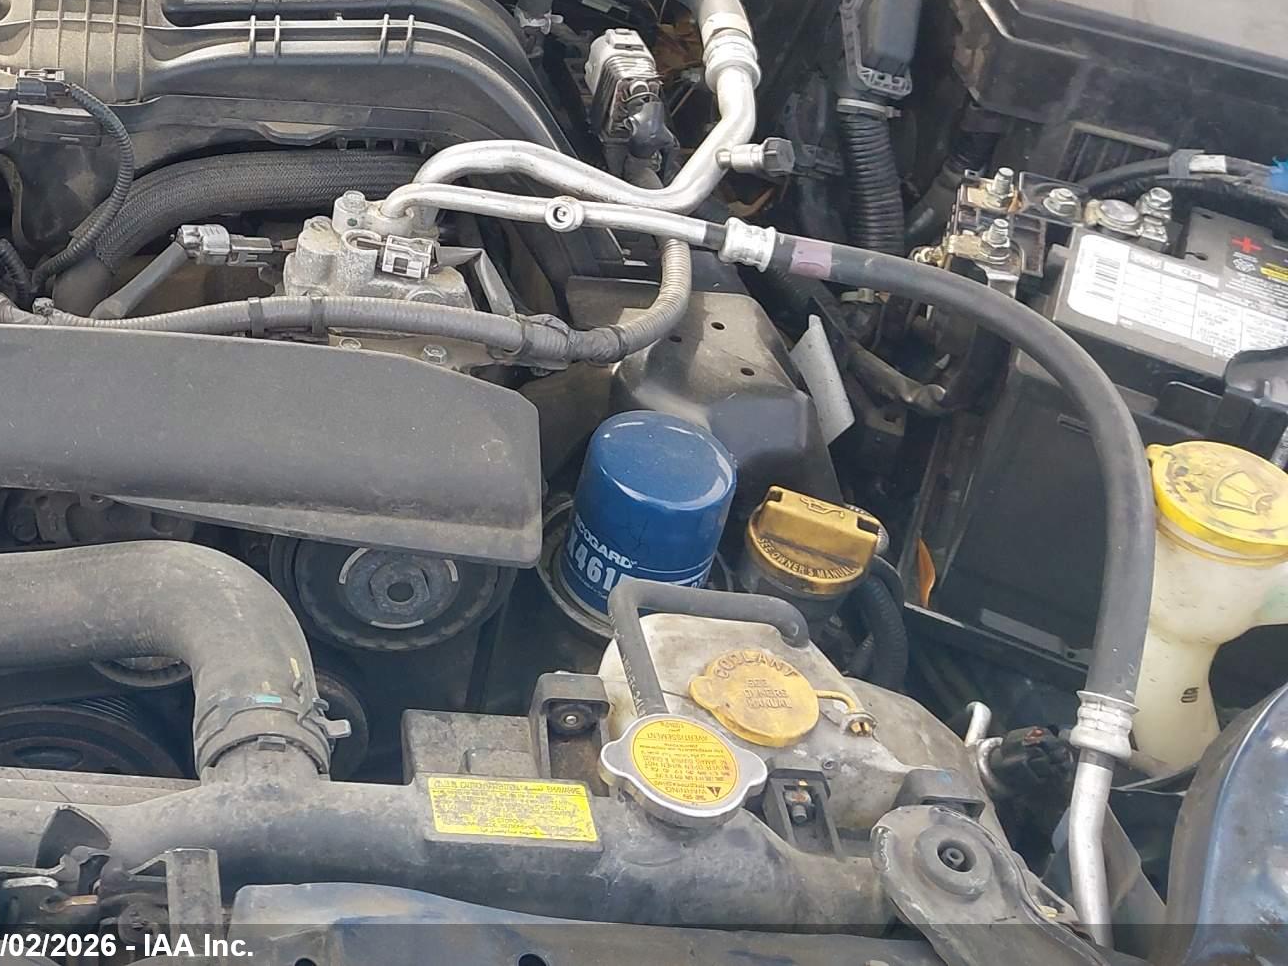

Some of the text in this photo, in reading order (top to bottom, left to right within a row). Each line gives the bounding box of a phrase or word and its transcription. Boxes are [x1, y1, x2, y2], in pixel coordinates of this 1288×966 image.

[757, 536, 775, 553] SEE
[816, 566, 856, 579] MANUAL
[713, 650, 798, 679] COOLANT
